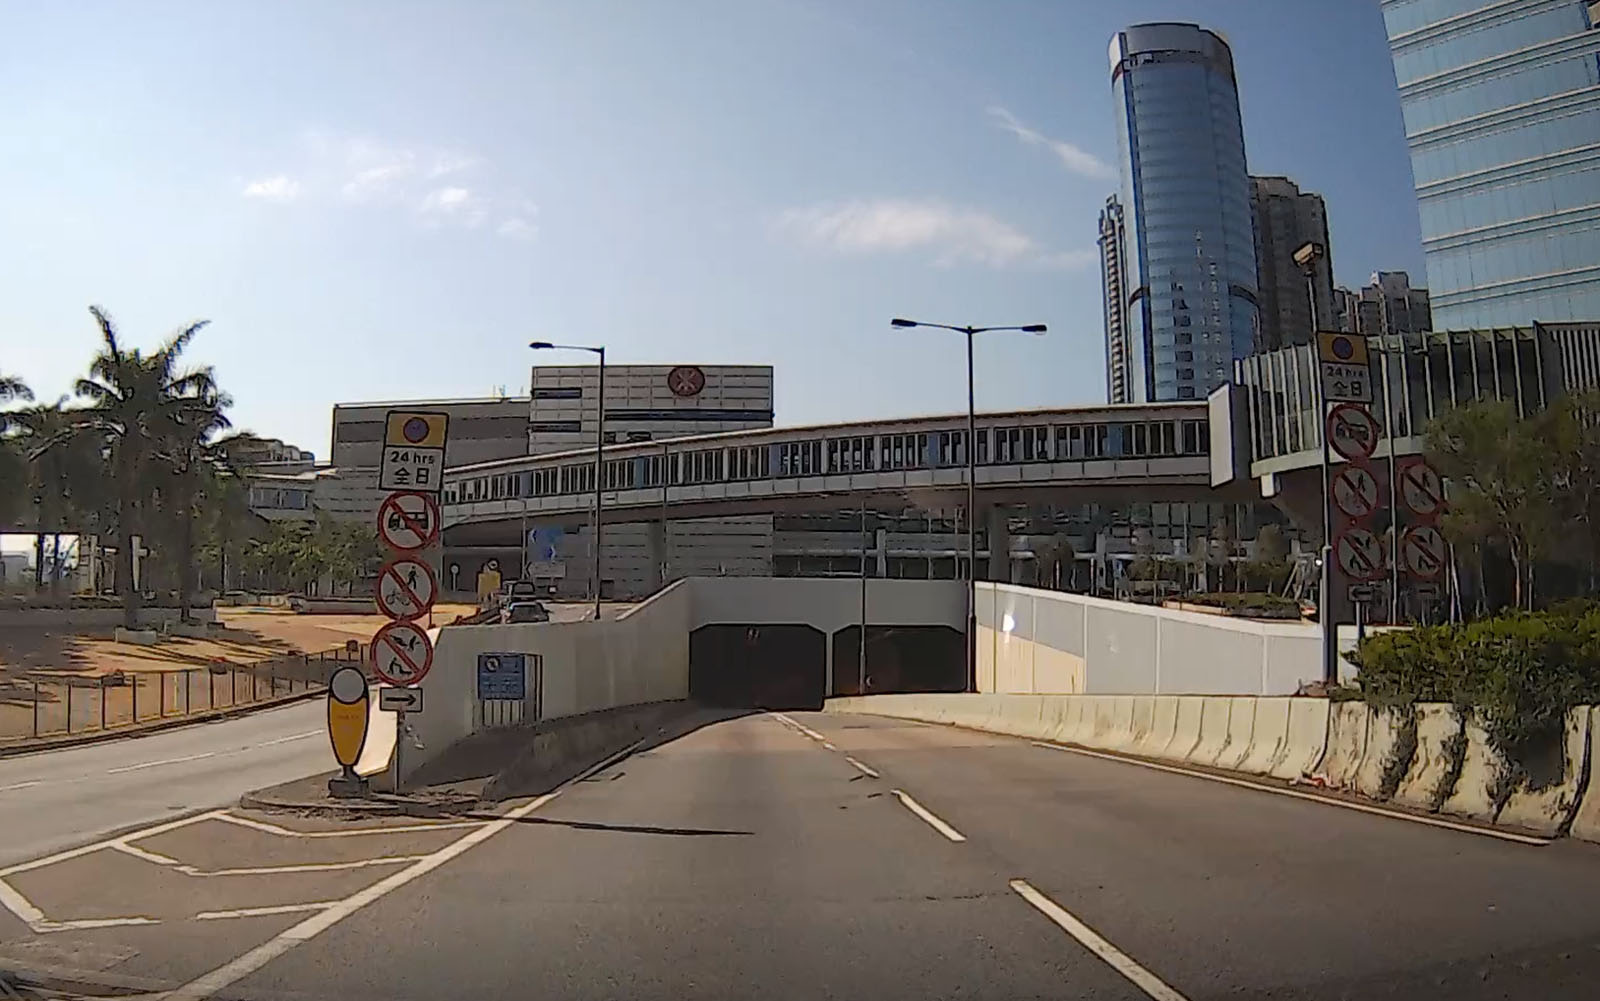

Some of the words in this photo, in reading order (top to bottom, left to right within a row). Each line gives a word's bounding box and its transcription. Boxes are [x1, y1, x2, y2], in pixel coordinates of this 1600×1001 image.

[1326, 365, 1343, 377] 24
[390, 450, 409, 463] 24
[413, 451, 435, 465] hrs
[393, 466, 430, 485] 全日
